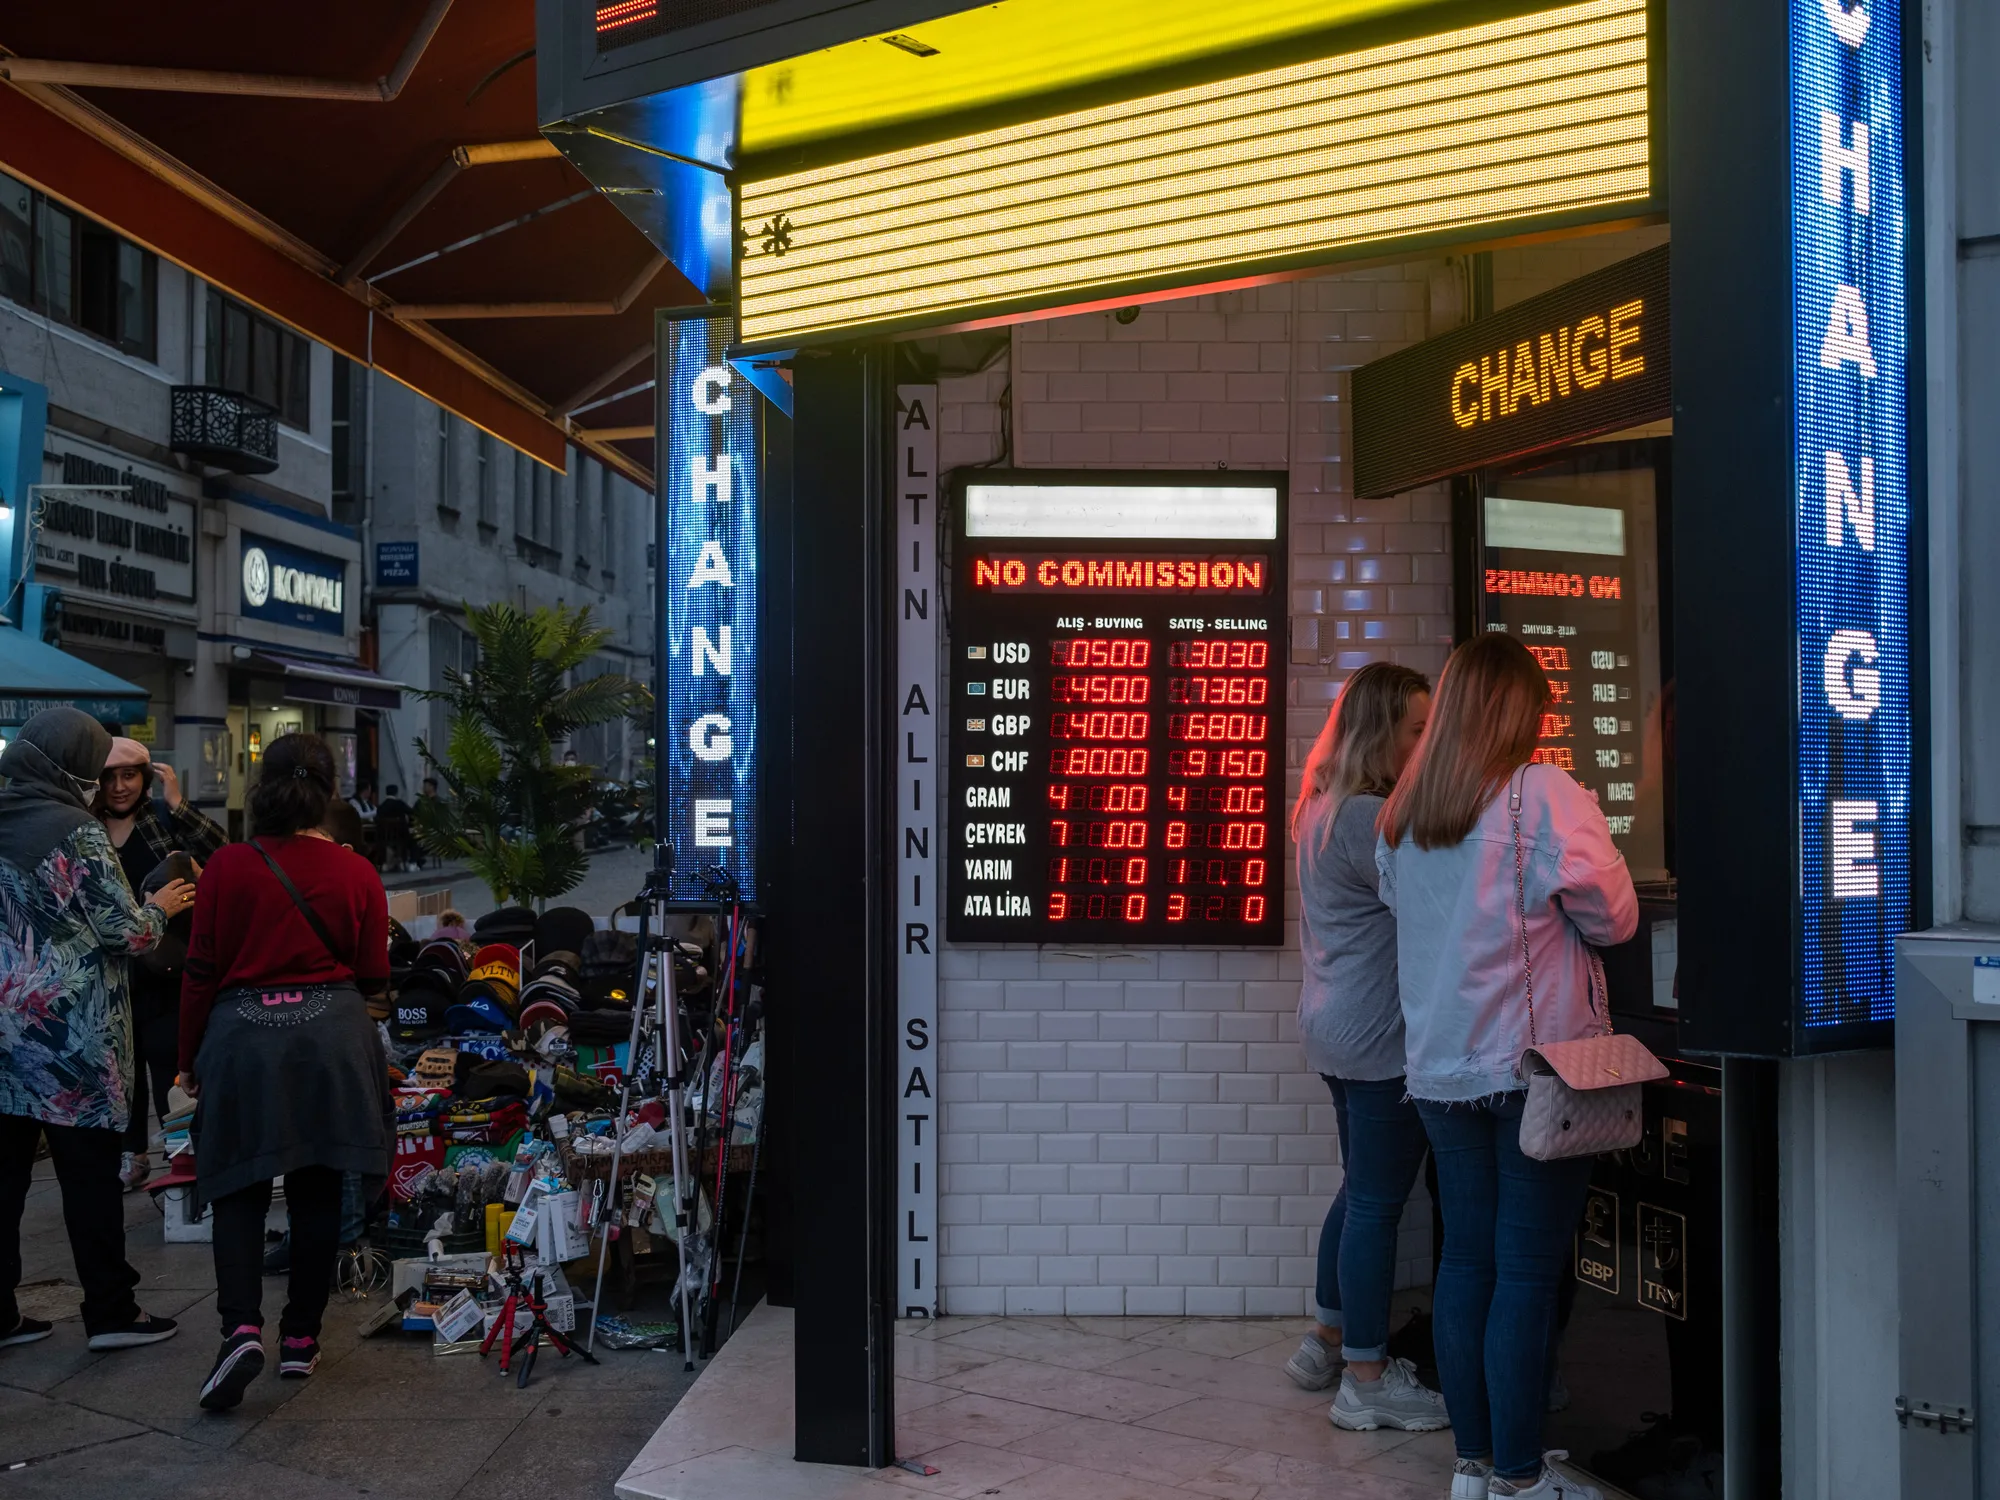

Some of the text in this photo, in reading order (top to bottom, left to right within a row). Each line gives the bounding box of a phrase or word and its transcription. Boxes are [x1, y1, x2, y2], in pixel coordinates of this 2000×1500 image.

[1452, 300, 1644, 428] CHANGE
[903, 400, 930, 620] ALTIN
[976, 560, 1262, 588] NO COMMISSION
[273, 564, 342, 614] KONYALI
[688, 365, 733, 847] CHANGE
[1095, 618, 1143, 629] BUYING
[1215, 619, 1268, 630] SELLING
[993, 643, 1031, 663] USD
[993, 679, 1031, 699] EUR
[992, 715, 1031, 735] GBP
[991, 751, 1029, 771] CHF
[966, 787, 1011, 808] GRAM
[903, 684, 931, 954] ALINIR
[965, 859, 1013, 880] YARIM
[964, 896, 992, 916] ATA
[996, 891, 1032, 917] LİRA
[480, 966, 515, 979] VLTN
[242, 990, 325, 1022] CHAMPION
[398, 1007, 428, 1020] BOSS
[1580, 1257, 1614, 1282] GBP
[1645, 1279, 1682, 1309] TRY
